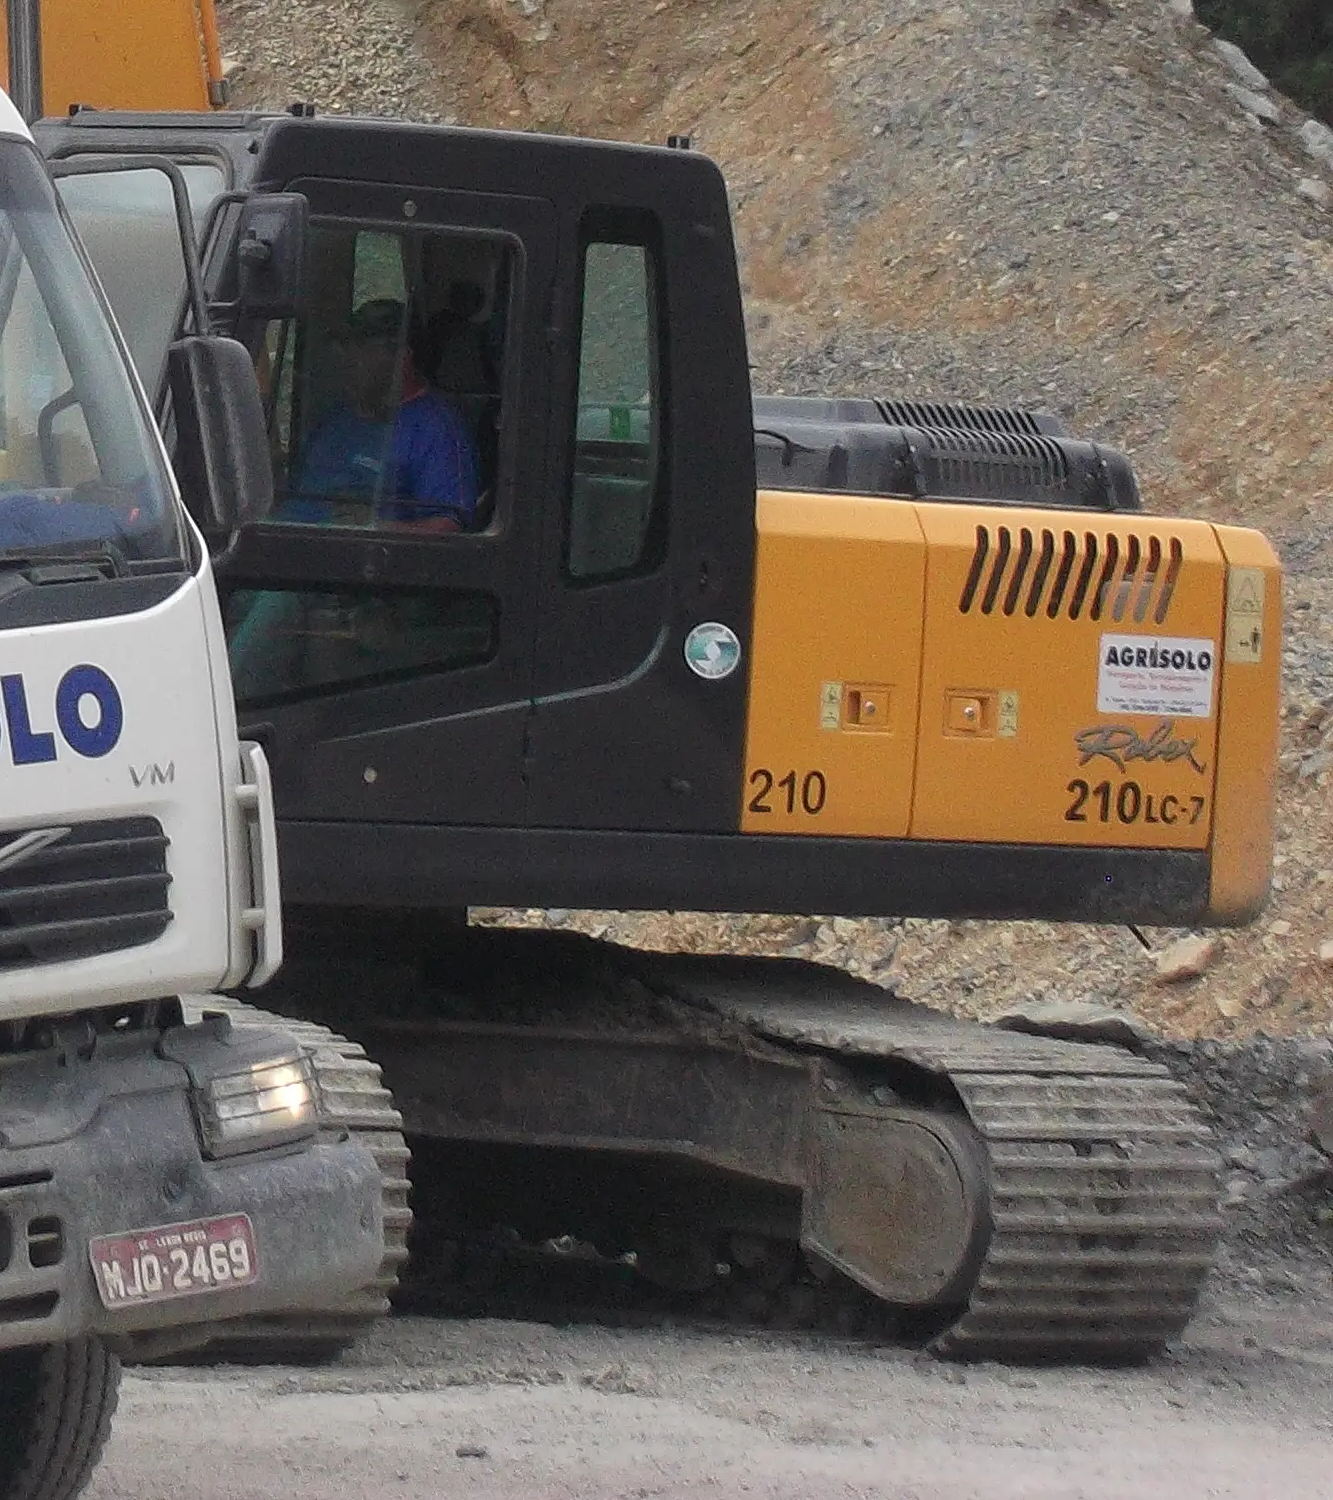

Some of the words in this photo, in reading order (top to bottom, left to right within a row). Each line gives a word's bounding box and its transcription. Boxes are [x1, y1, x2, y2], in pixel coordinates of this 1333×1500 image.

[1105, 641, 1211, 671] AGRISOLO
[129, 761, 176, 789] VM
[748, 768, 827, 815] 210
[1064, 779, 1205, 825] 210LC-7
